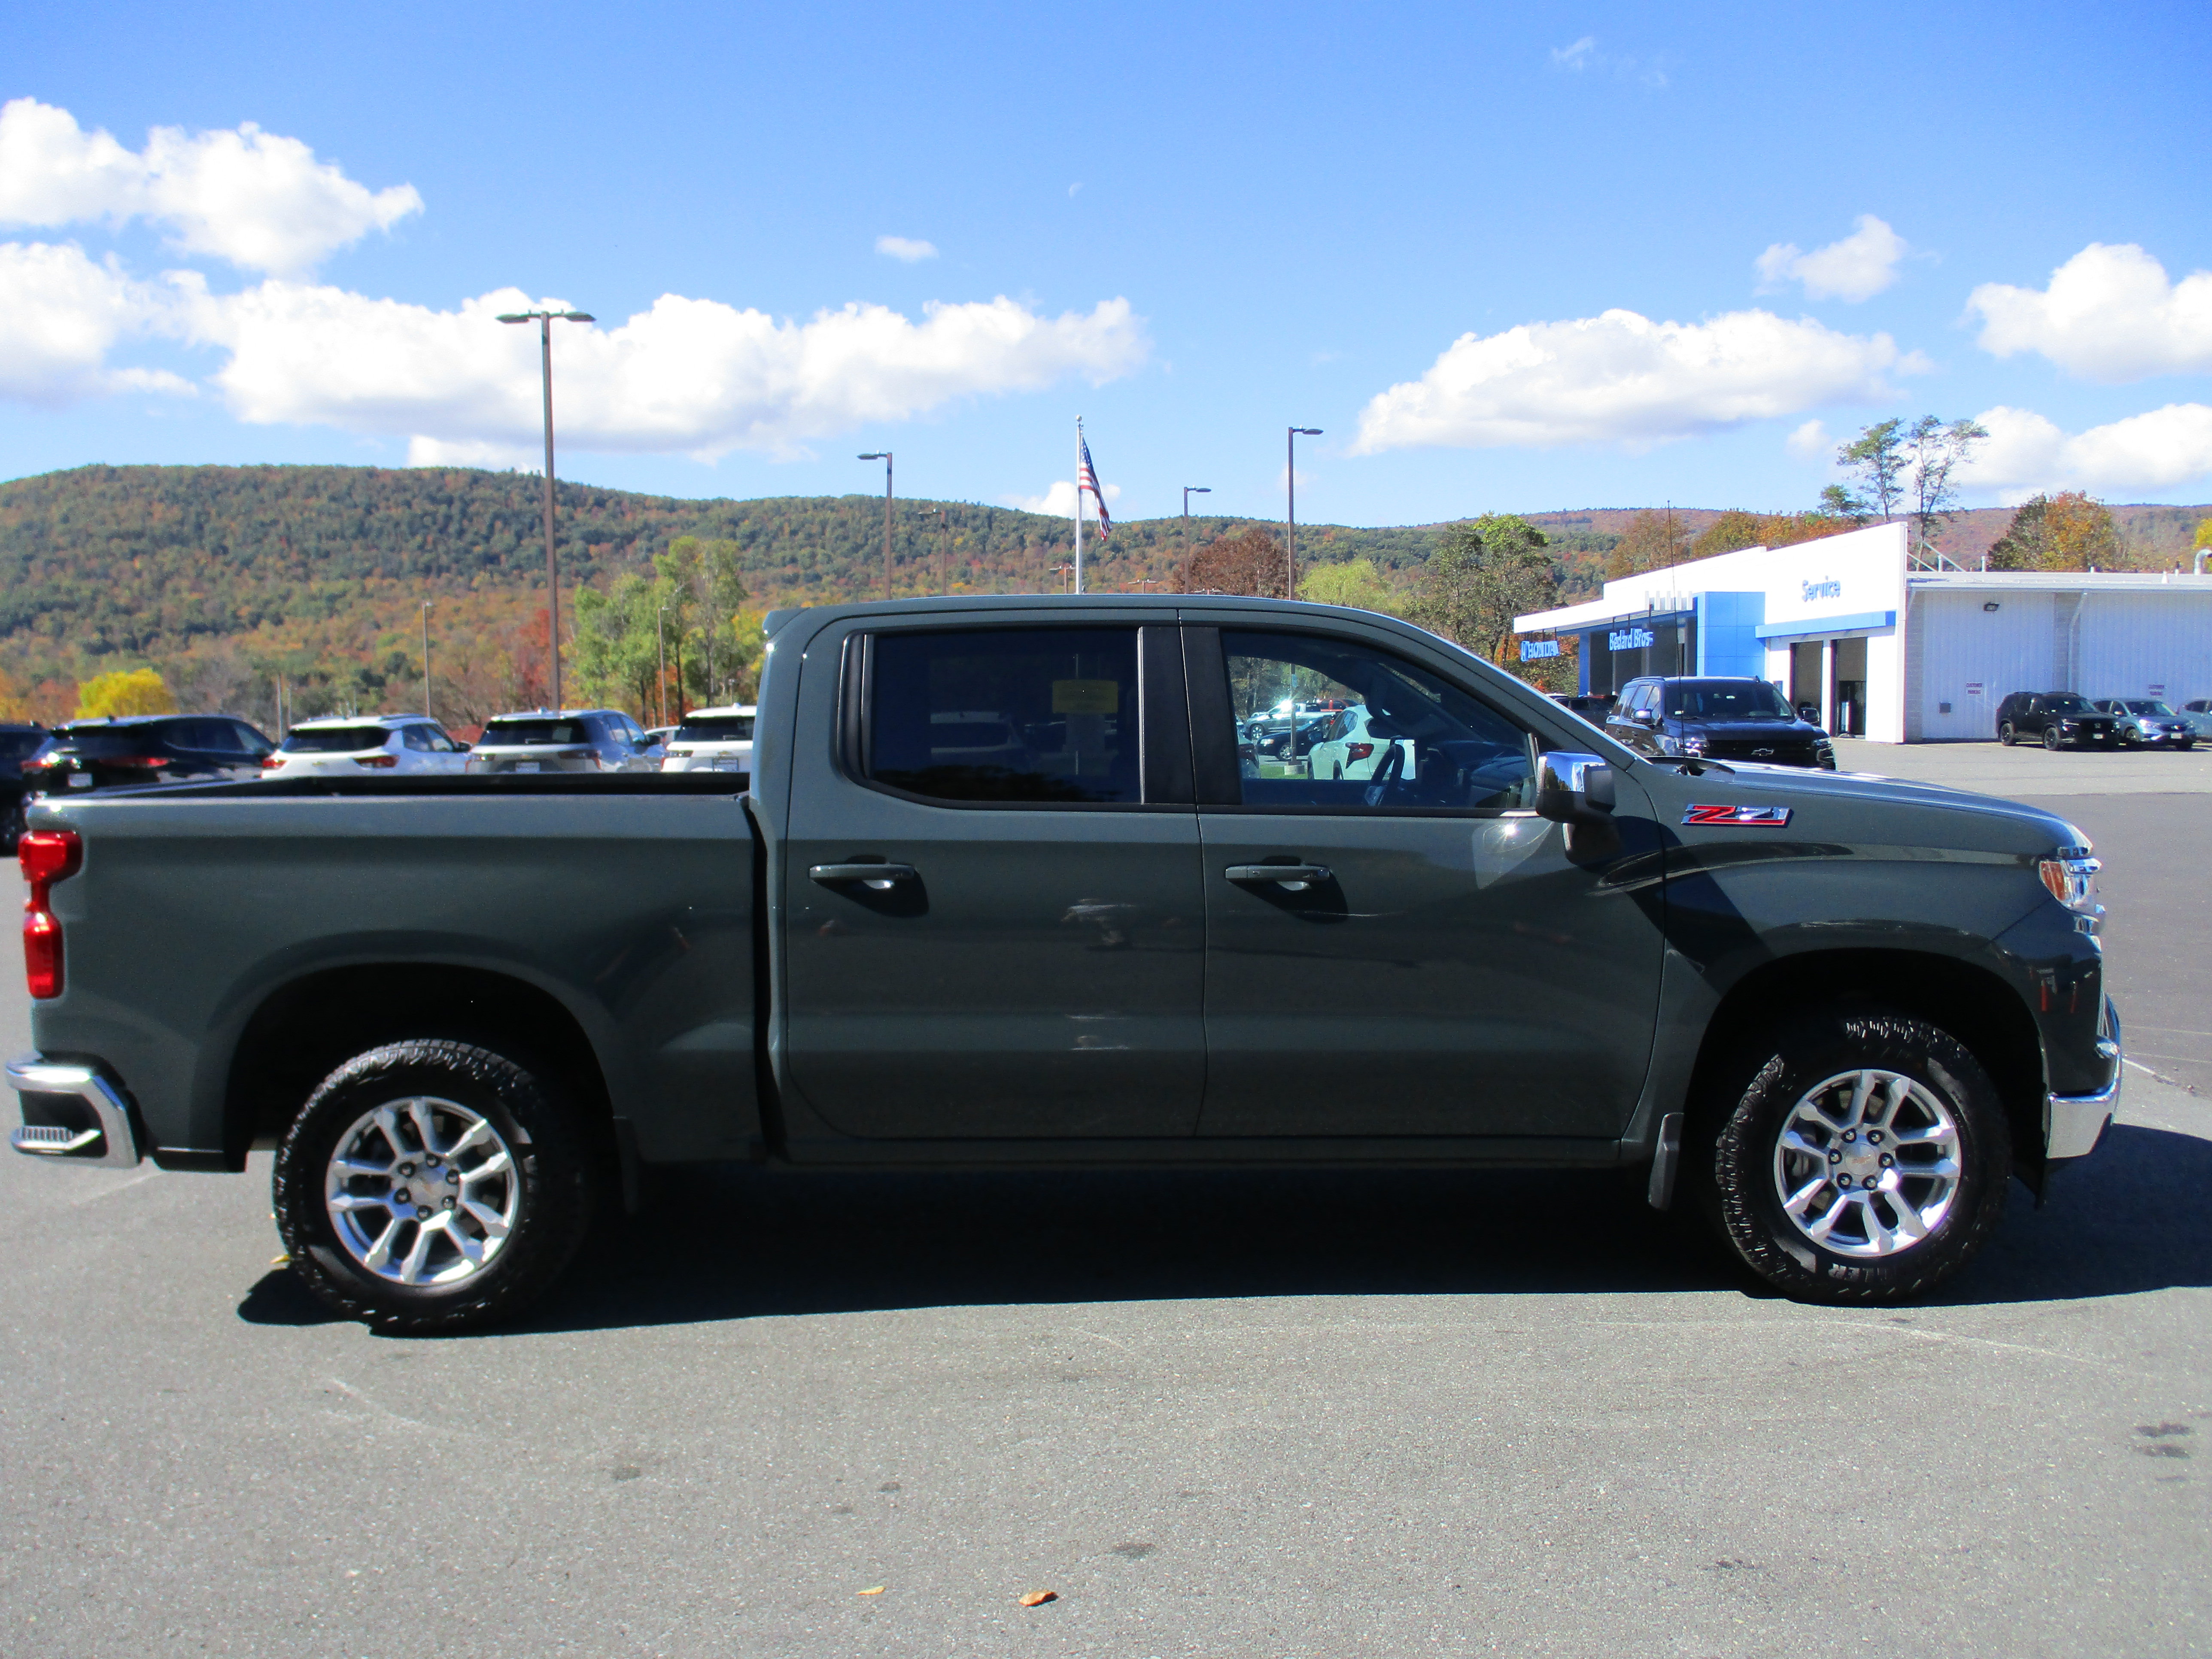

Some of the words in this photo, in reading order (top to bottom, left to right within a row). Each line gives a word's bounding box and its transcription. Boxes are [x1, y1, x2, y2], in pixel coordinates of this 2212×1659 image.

[1802, 575, 1840, 602] Service
[1528, 641, 1559, 658] HONDA
[1609, 628, 1633, 651] Bedard
[1681, 804, 1790, 826] Z71
